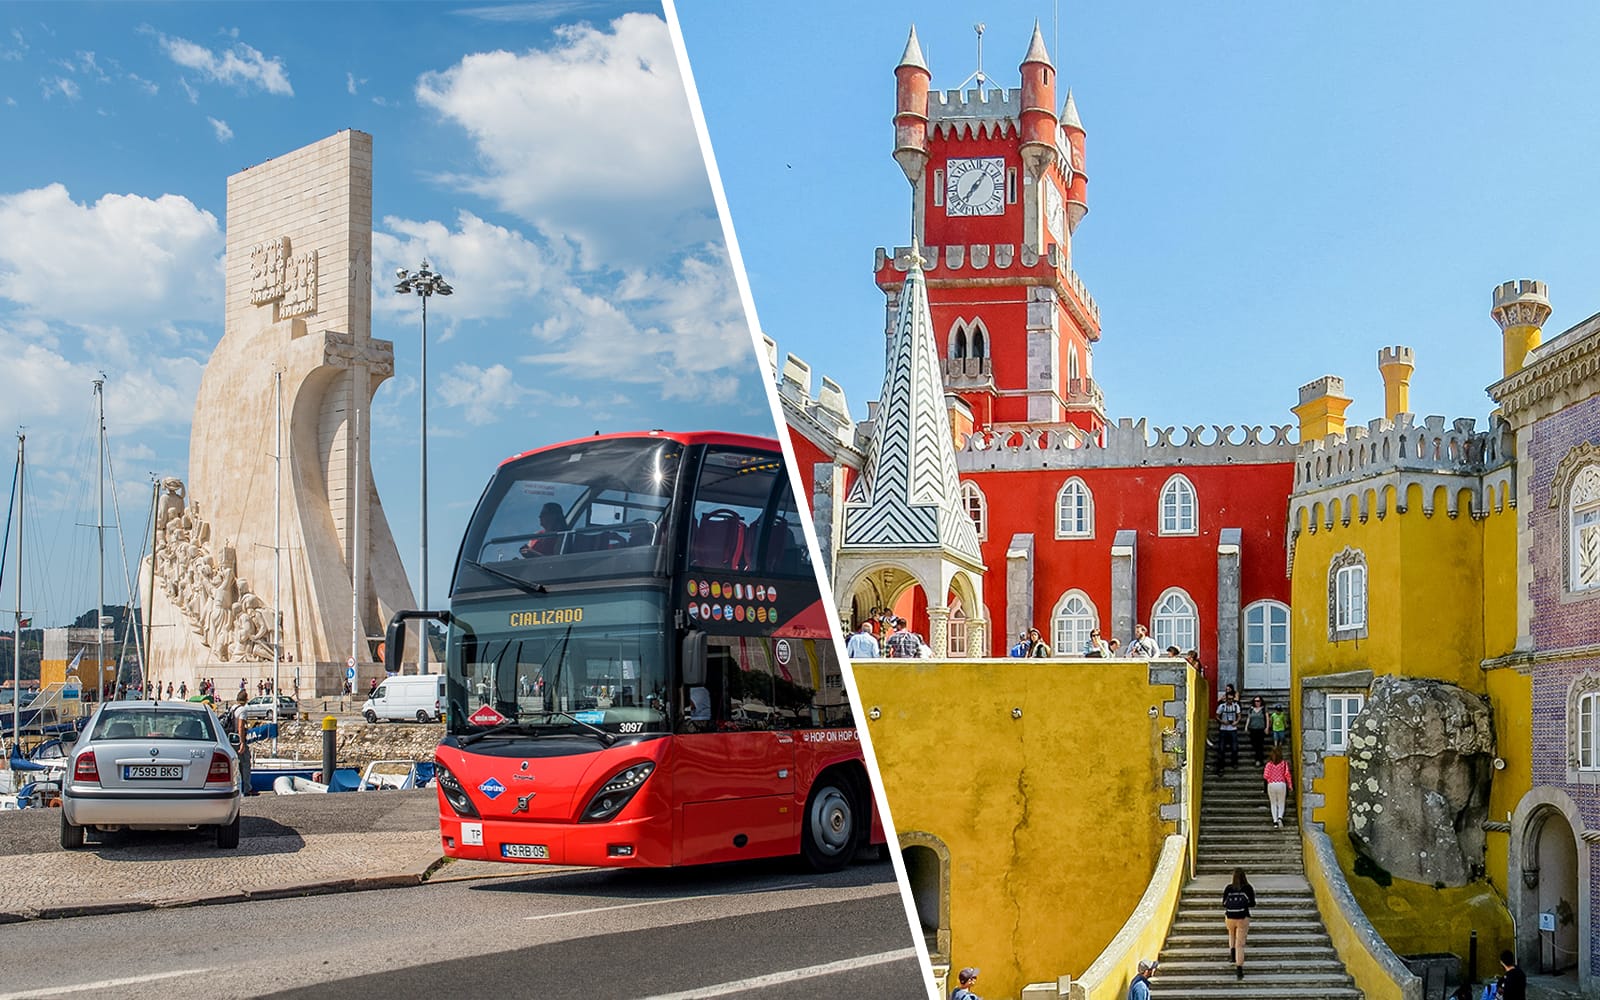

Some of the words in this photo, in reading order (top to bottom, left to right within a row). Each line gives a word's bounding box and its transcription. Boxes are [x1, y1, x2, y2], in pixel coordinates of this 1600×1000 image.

[510, 608, 583, 627] CIALIZADO
[619, 722, 643, 733] 3097
[810, 731, 825, 743] HOP
[826, 731, 838, 742] ON
[838, 730, 853, 741] HOP
[132, 767, 157, 777] 7599
[160, 767, 179, 777] BKS
[471, 829, 482, 839] TP
